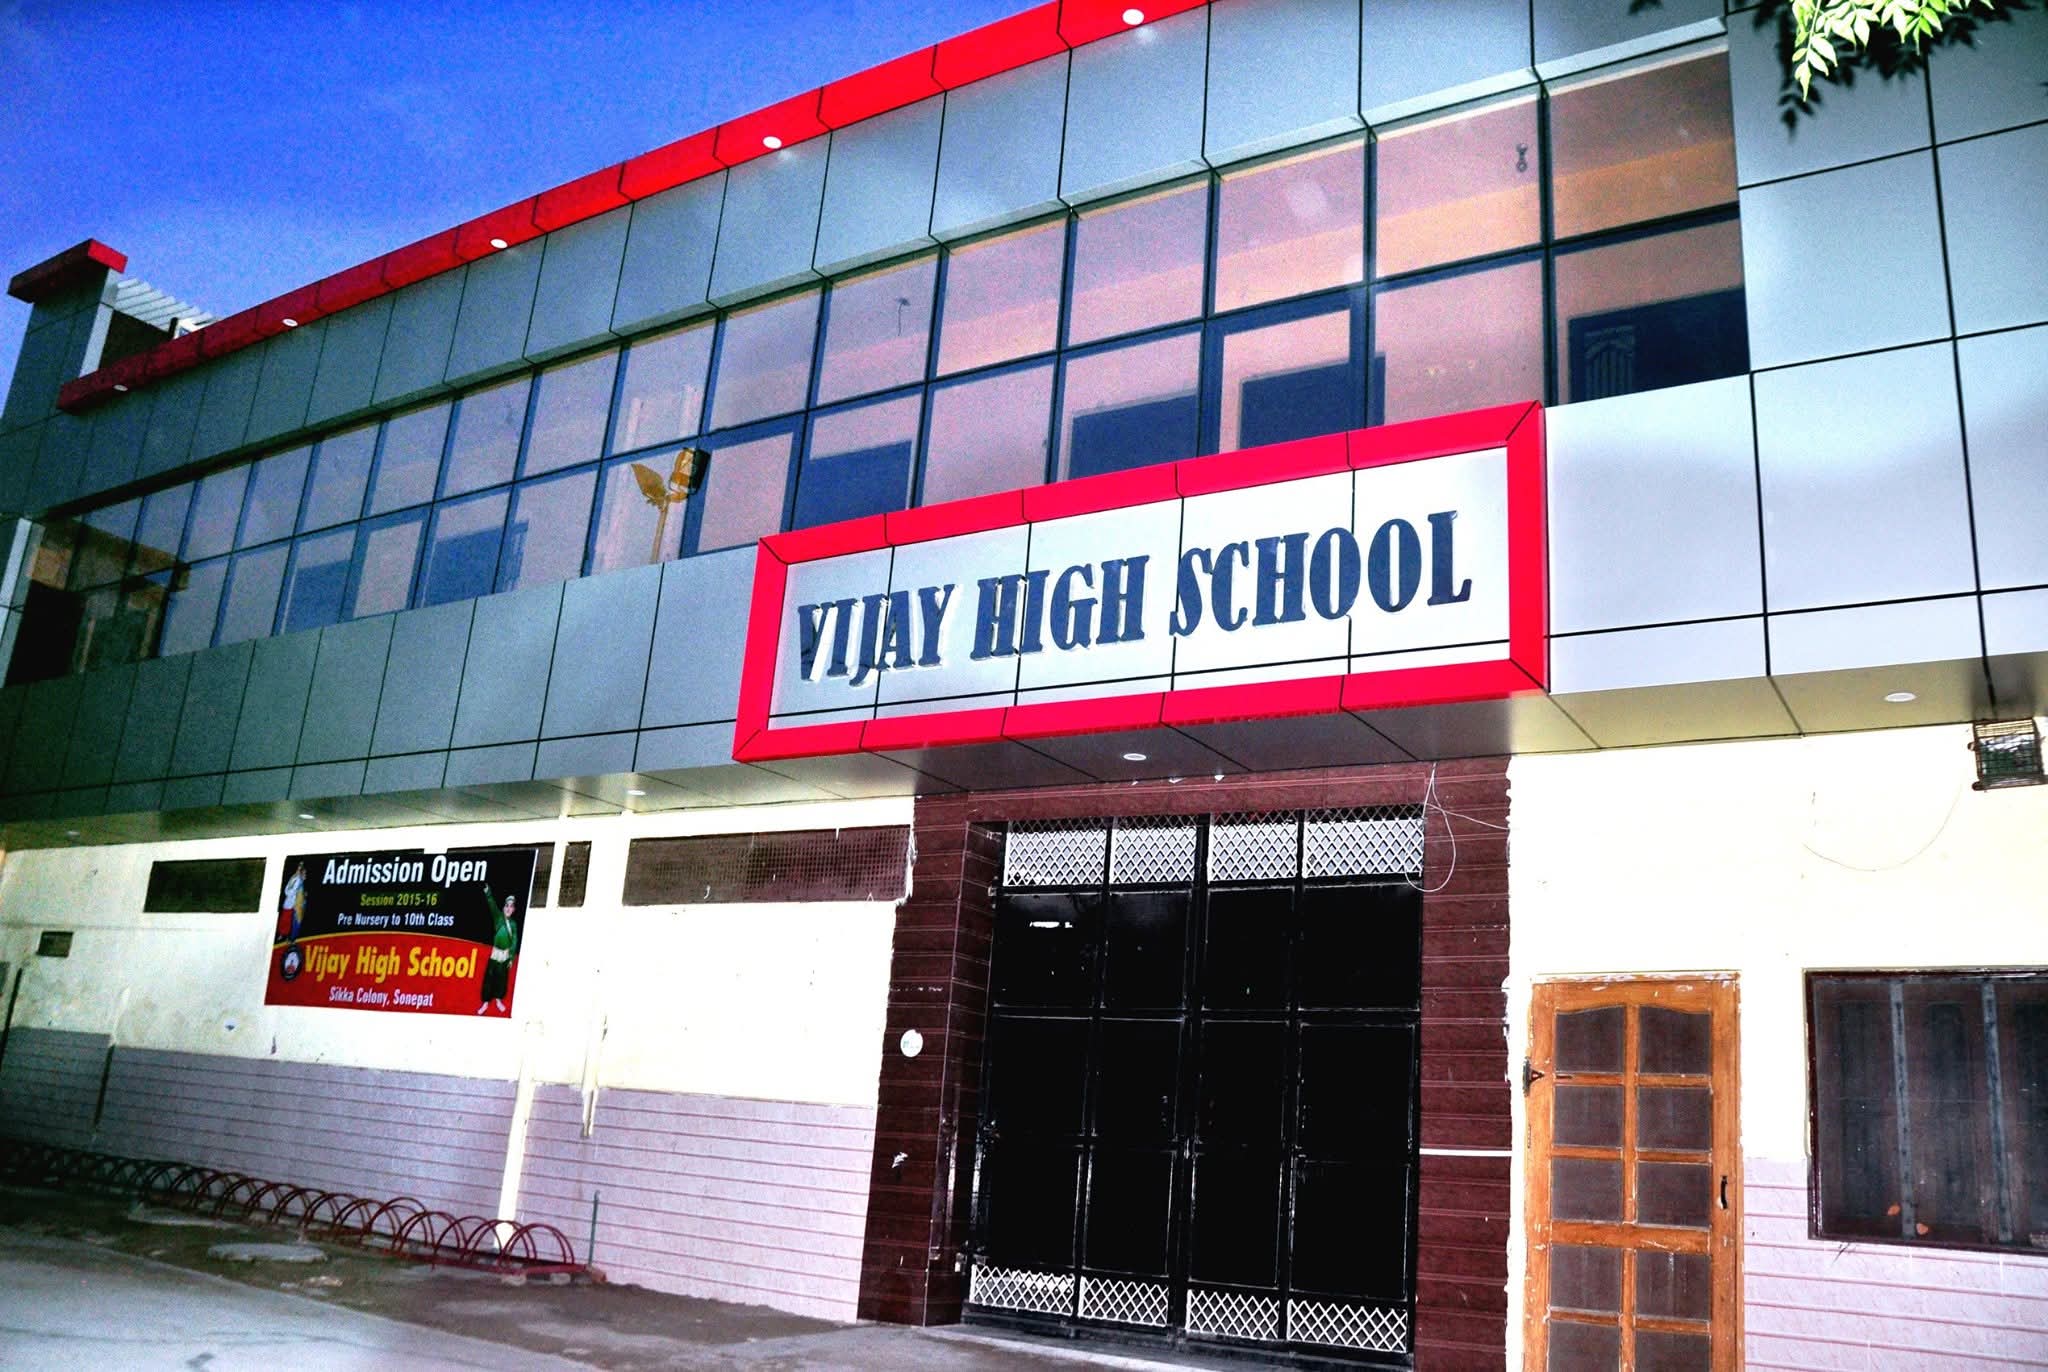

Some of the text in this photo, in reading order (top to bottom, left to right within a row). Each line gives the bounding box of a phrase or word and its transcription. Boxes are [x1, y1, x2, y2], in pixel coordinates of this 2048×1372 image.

[798, 509, 1473, 687] VIJAY HIGH SCHOOL
[323, 855, 487, 887] Admission Open
[360, 892, 438, 907] Session 2015-16
[337, 911, 455, 928] Pre Nursery to 10th Class
[304, 945, 478, 984] Vijay High School
[329, 986, 355, 1003] Sikka
[393, 988, 434, 1008] Sonepat
